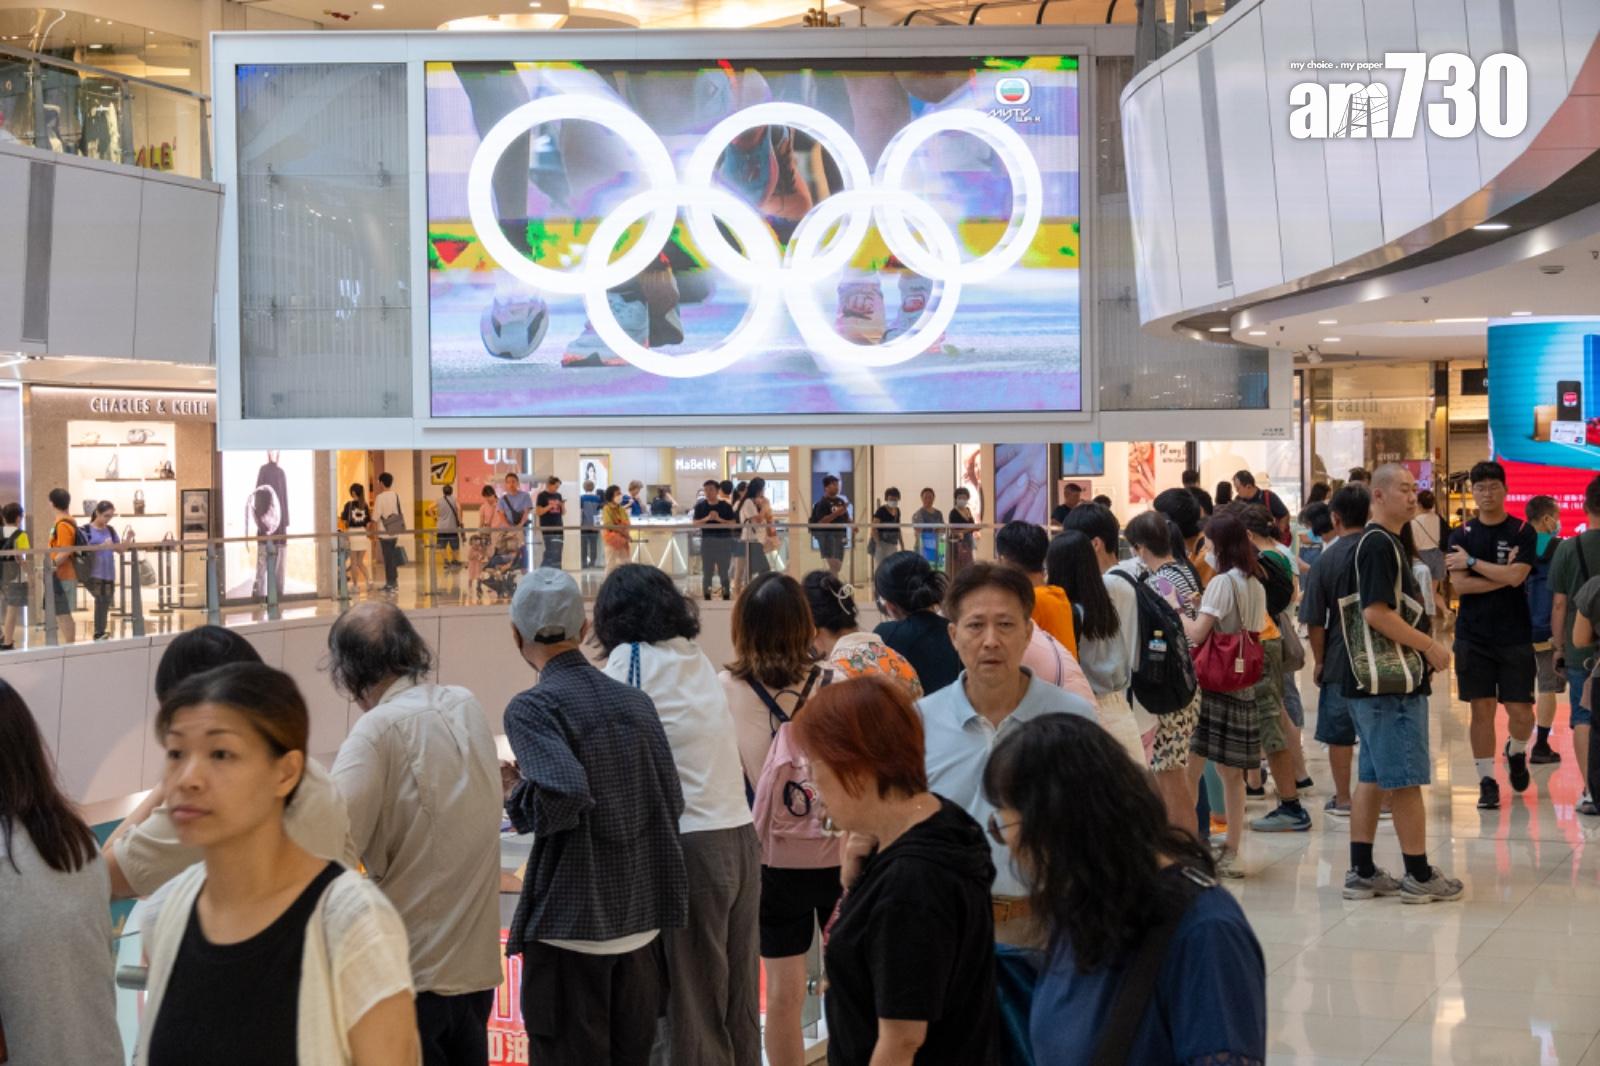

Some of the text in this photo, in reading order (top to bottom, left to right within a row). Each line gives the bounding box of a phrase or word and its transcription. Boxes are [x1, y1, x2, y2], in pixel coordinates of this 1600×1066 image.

[90, 397, 209, 415] CHARLES & KEITH
